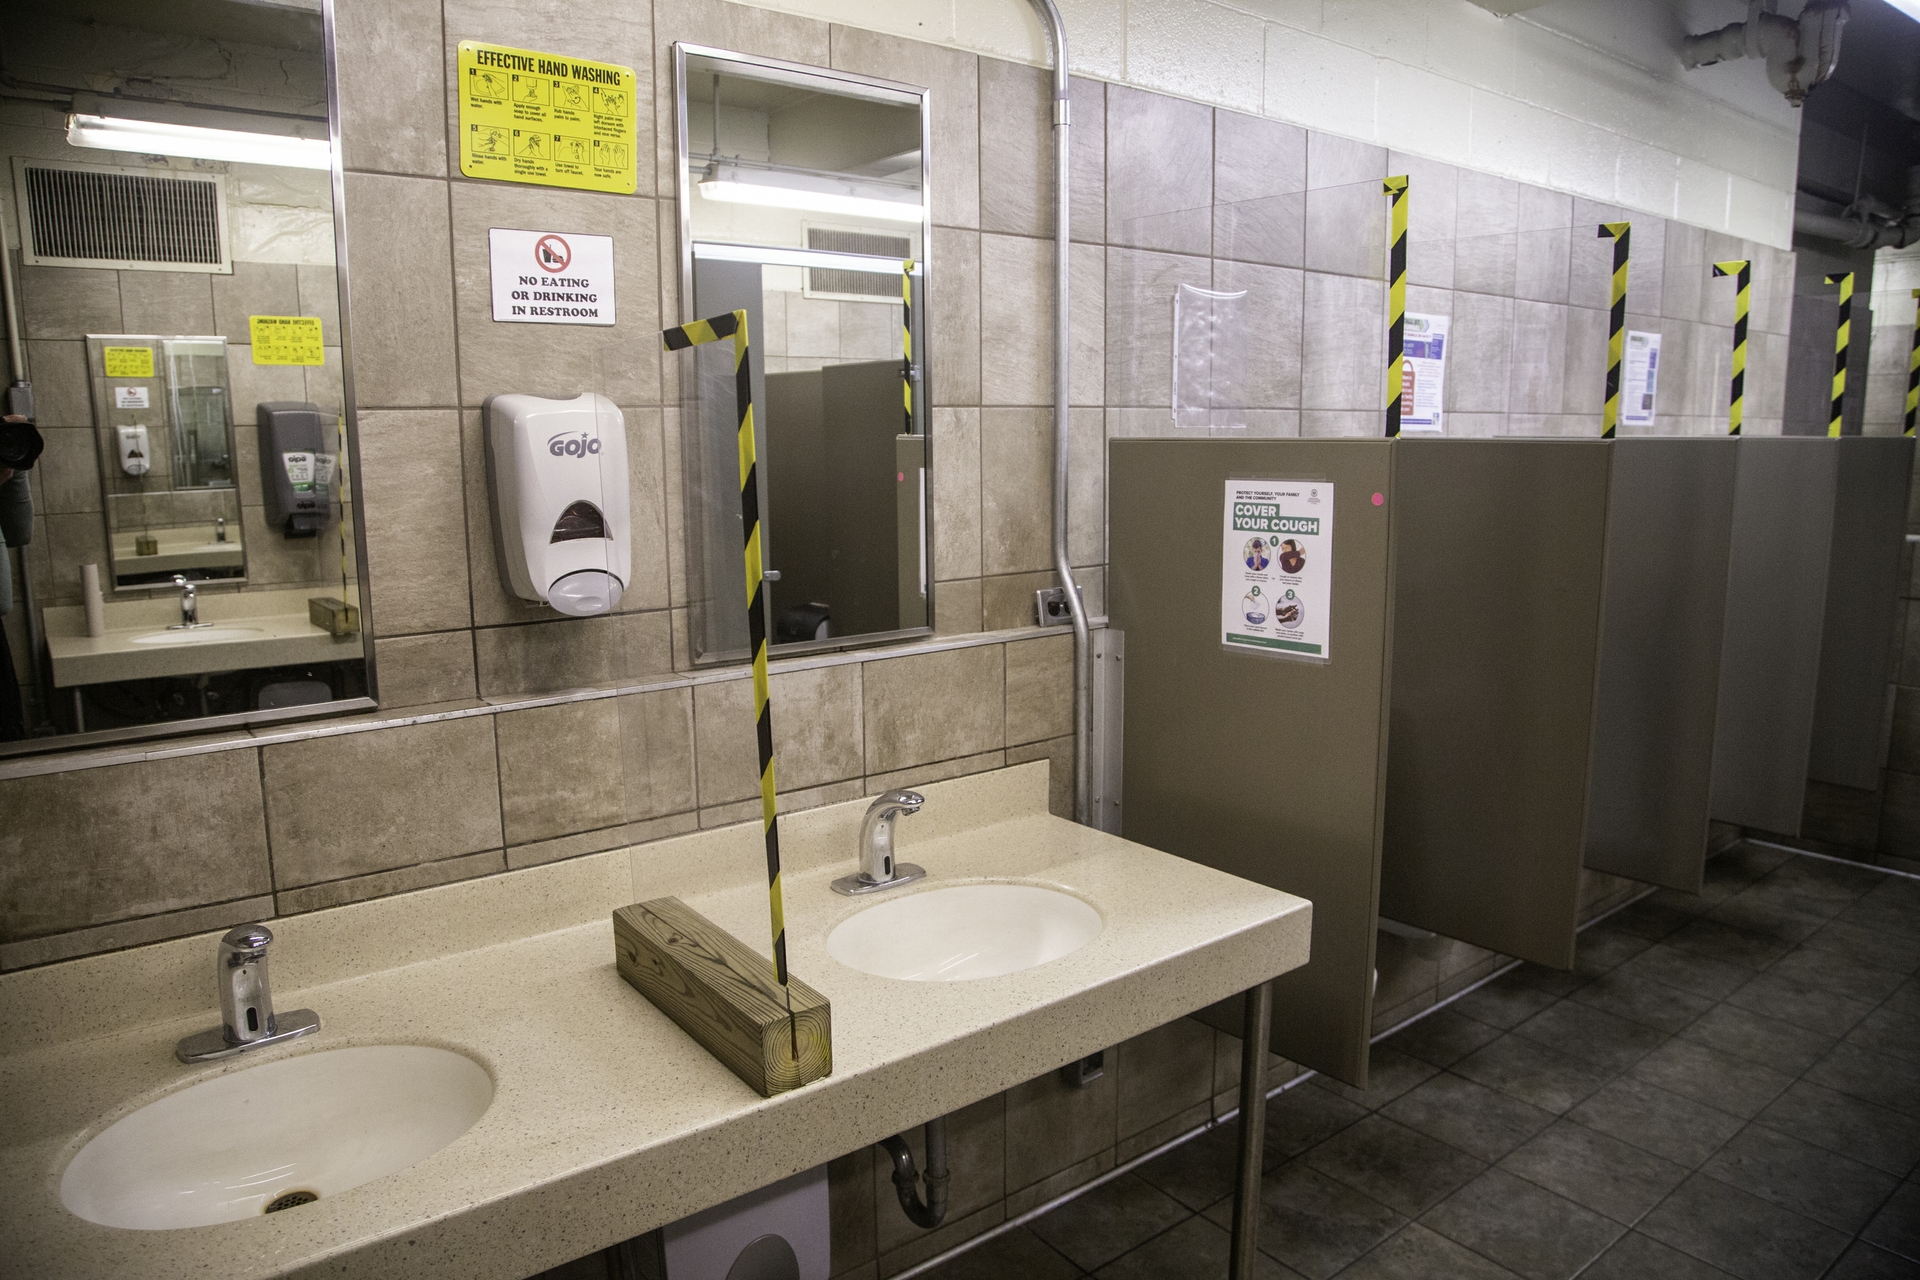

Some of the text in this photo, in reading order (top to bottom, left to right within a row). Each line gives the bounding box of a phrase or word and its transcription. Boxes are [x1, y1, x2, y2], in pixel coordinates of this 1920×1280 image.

[477, 50, 620, 86] EFFECTIVE HAND WASHING
[518, 276, 589, 288] NO EATING
[511, 291, 598, 303] OR DRINKING
[512, 306, 598, 317] IN RESTROOM
[1235, 504, 1277, 517] COVER
[1235, 517, 1317, 532] YOUR COUGH
